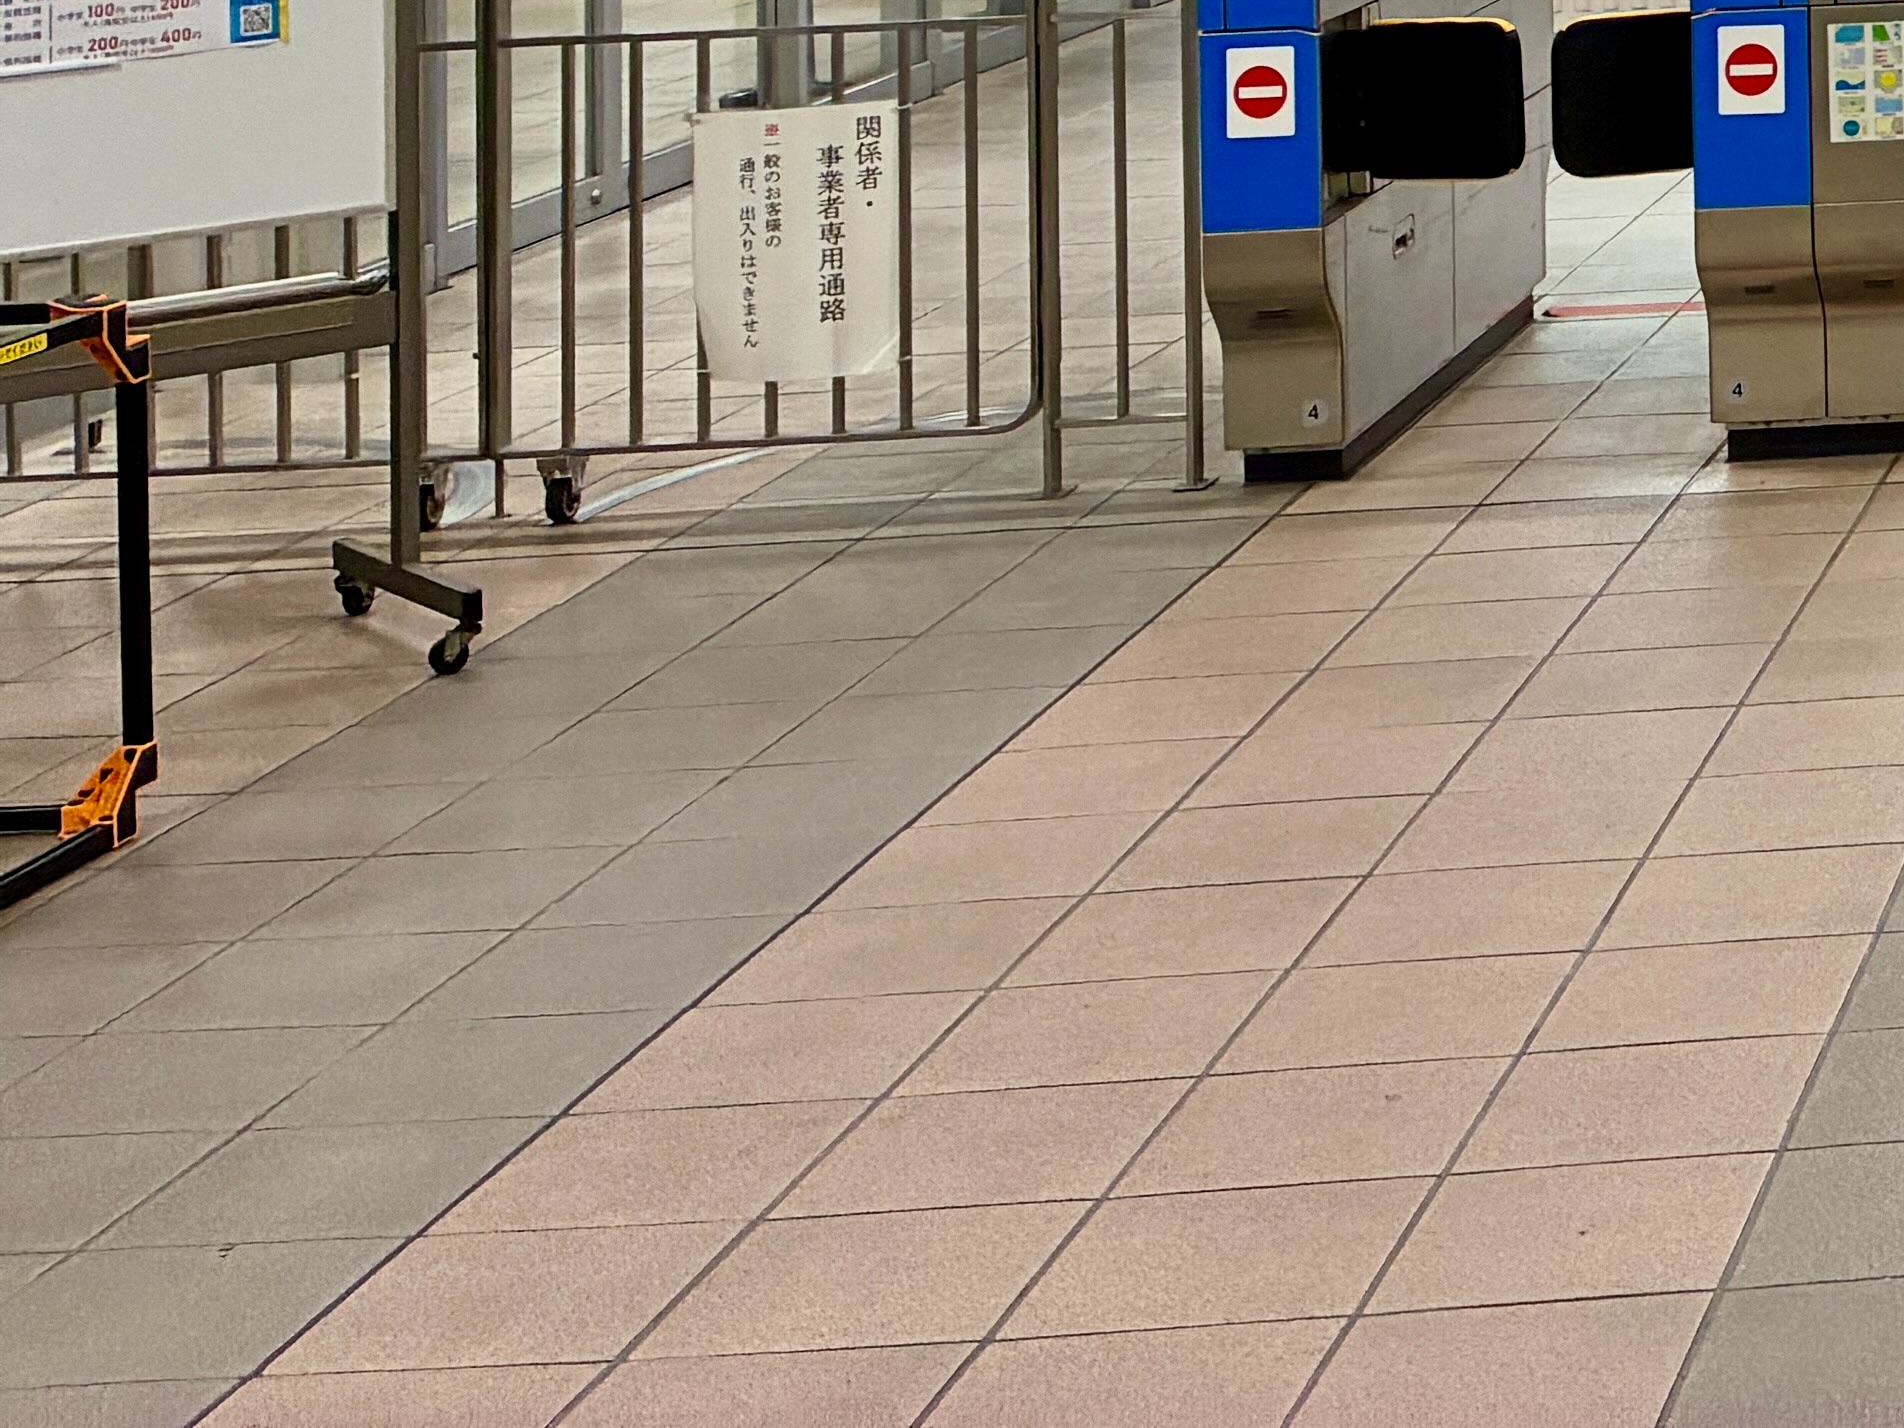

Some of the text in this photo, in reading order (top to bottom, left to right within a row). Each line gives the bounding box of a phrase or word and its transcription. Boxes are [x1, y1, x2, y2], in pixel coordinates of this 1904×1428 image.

[816, 145, 847, 324] 事業者専用通路
